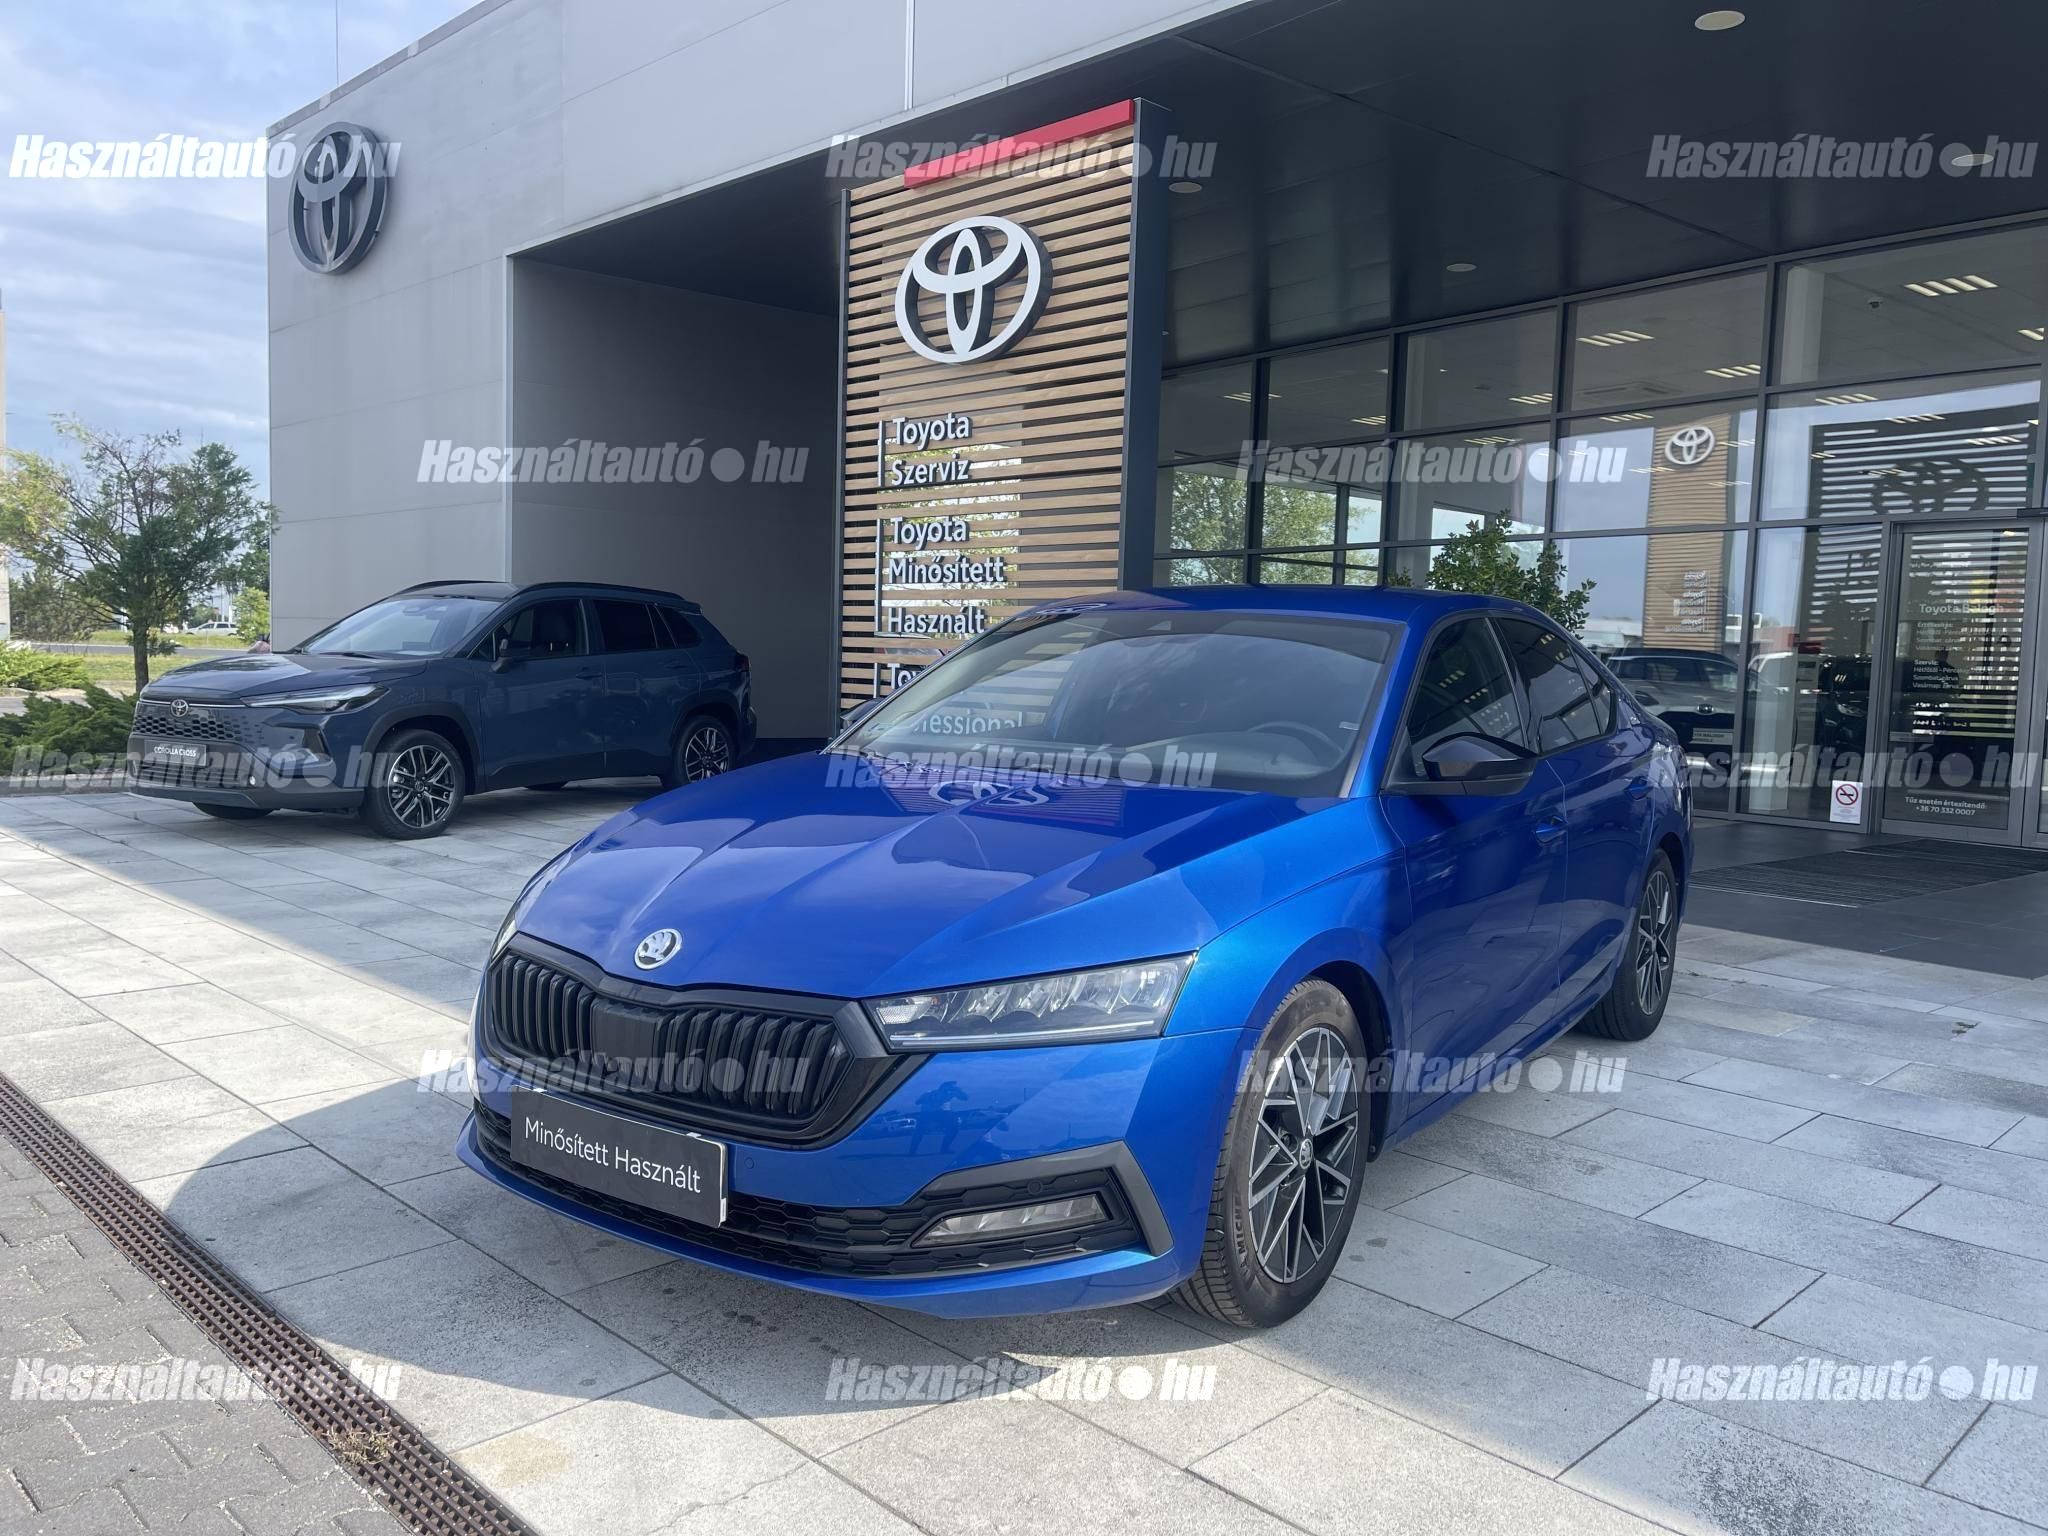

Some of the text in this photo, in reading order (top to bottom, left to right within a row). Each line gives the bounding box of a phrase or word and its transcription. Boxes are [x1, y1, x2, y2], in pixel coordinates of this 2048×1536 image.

[892, 412, 971, 450] Toyota
[891, 453, 970, 486] Szerviz
[890, 516, 969, 549] Toyota
[888, 554, 1005, 585] Minősített
[888, 606, 986, 635] Használt
[1920, 603, 1960, 615] Toyota
[525, 1117, 701, 1194] Minősített Használt
